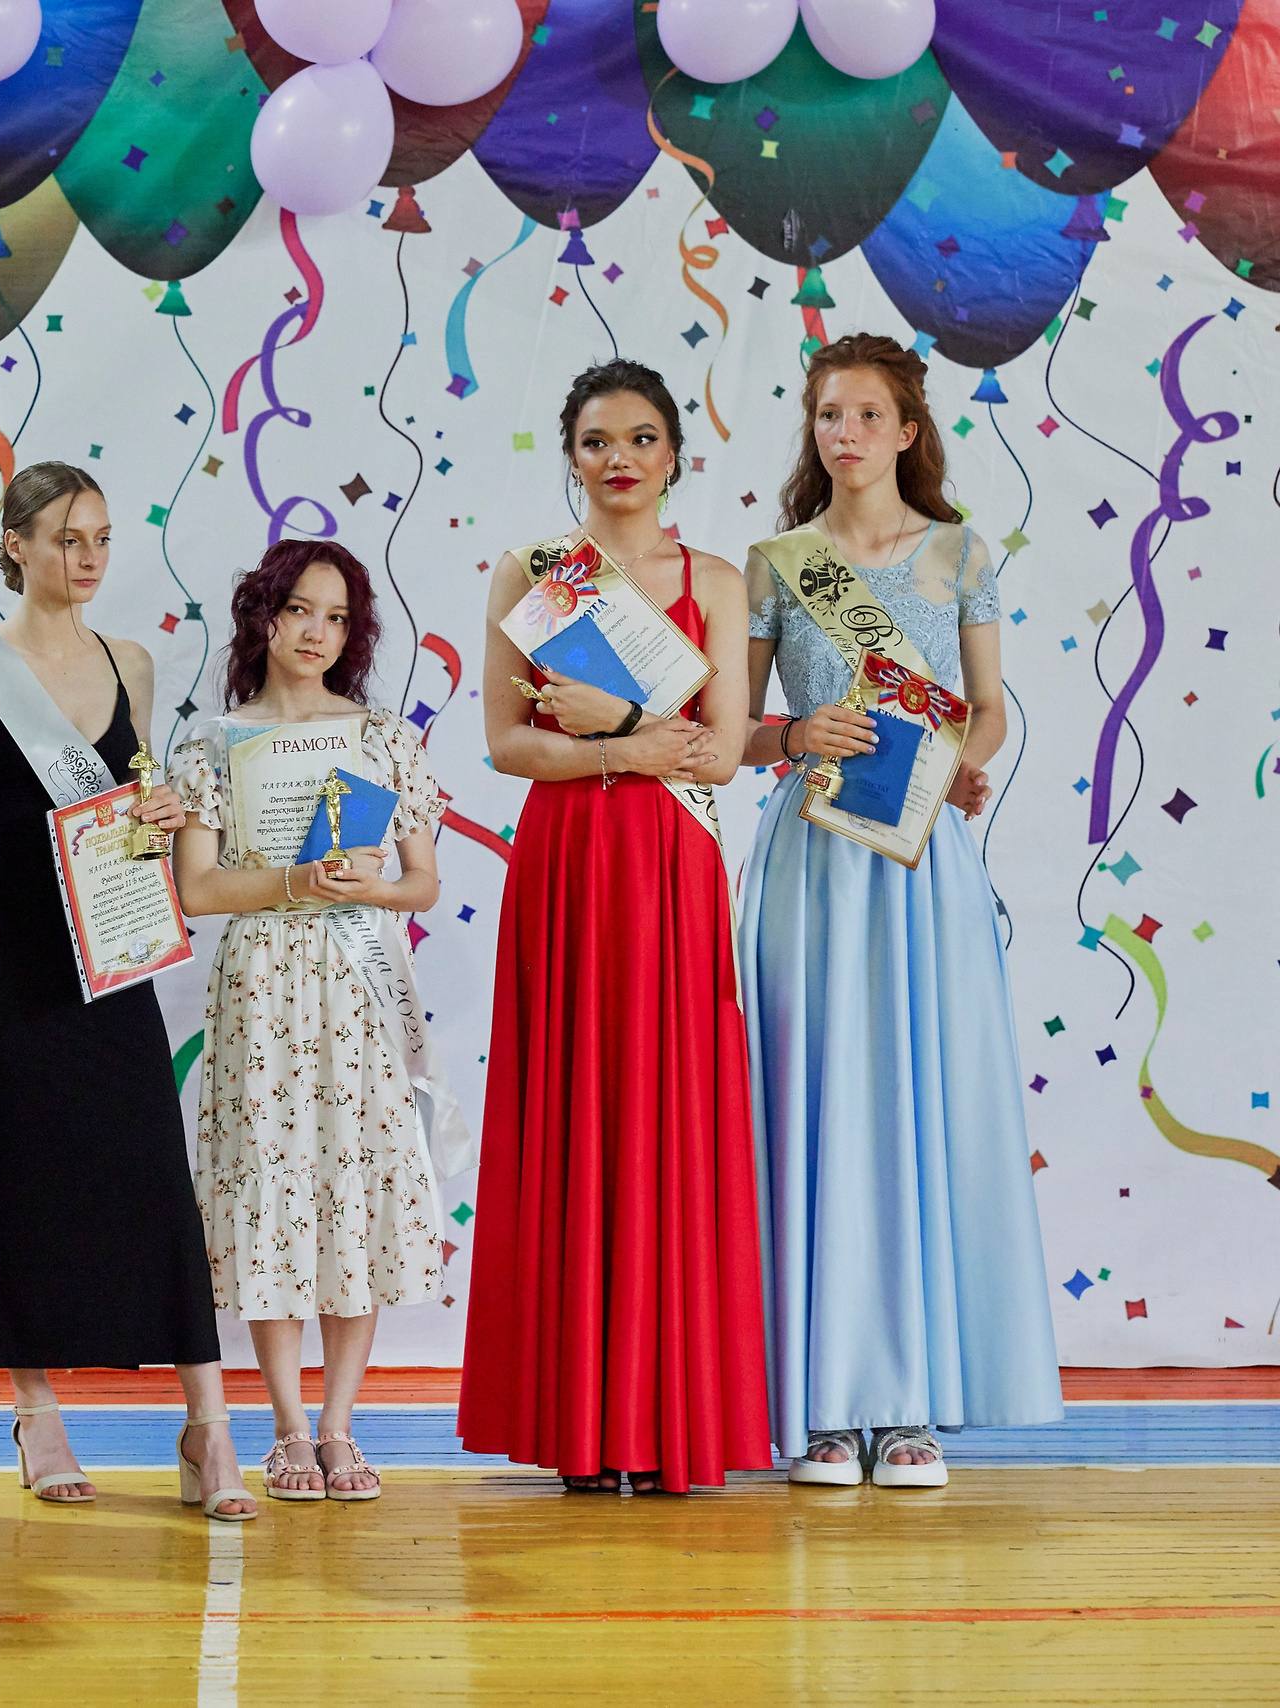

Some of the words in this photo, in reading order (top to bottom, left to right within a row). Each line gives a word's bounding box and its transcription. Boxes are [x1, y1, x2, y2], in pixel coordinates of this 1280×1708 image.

[272, 736, 348, 754] ГРАМОТА
[261, 778, 330, 790] НАГРАЖДАЕ
[88, 853, 133, 874] НАГРАЖДАЕ
[385, 979, 424, 1053] 2023
